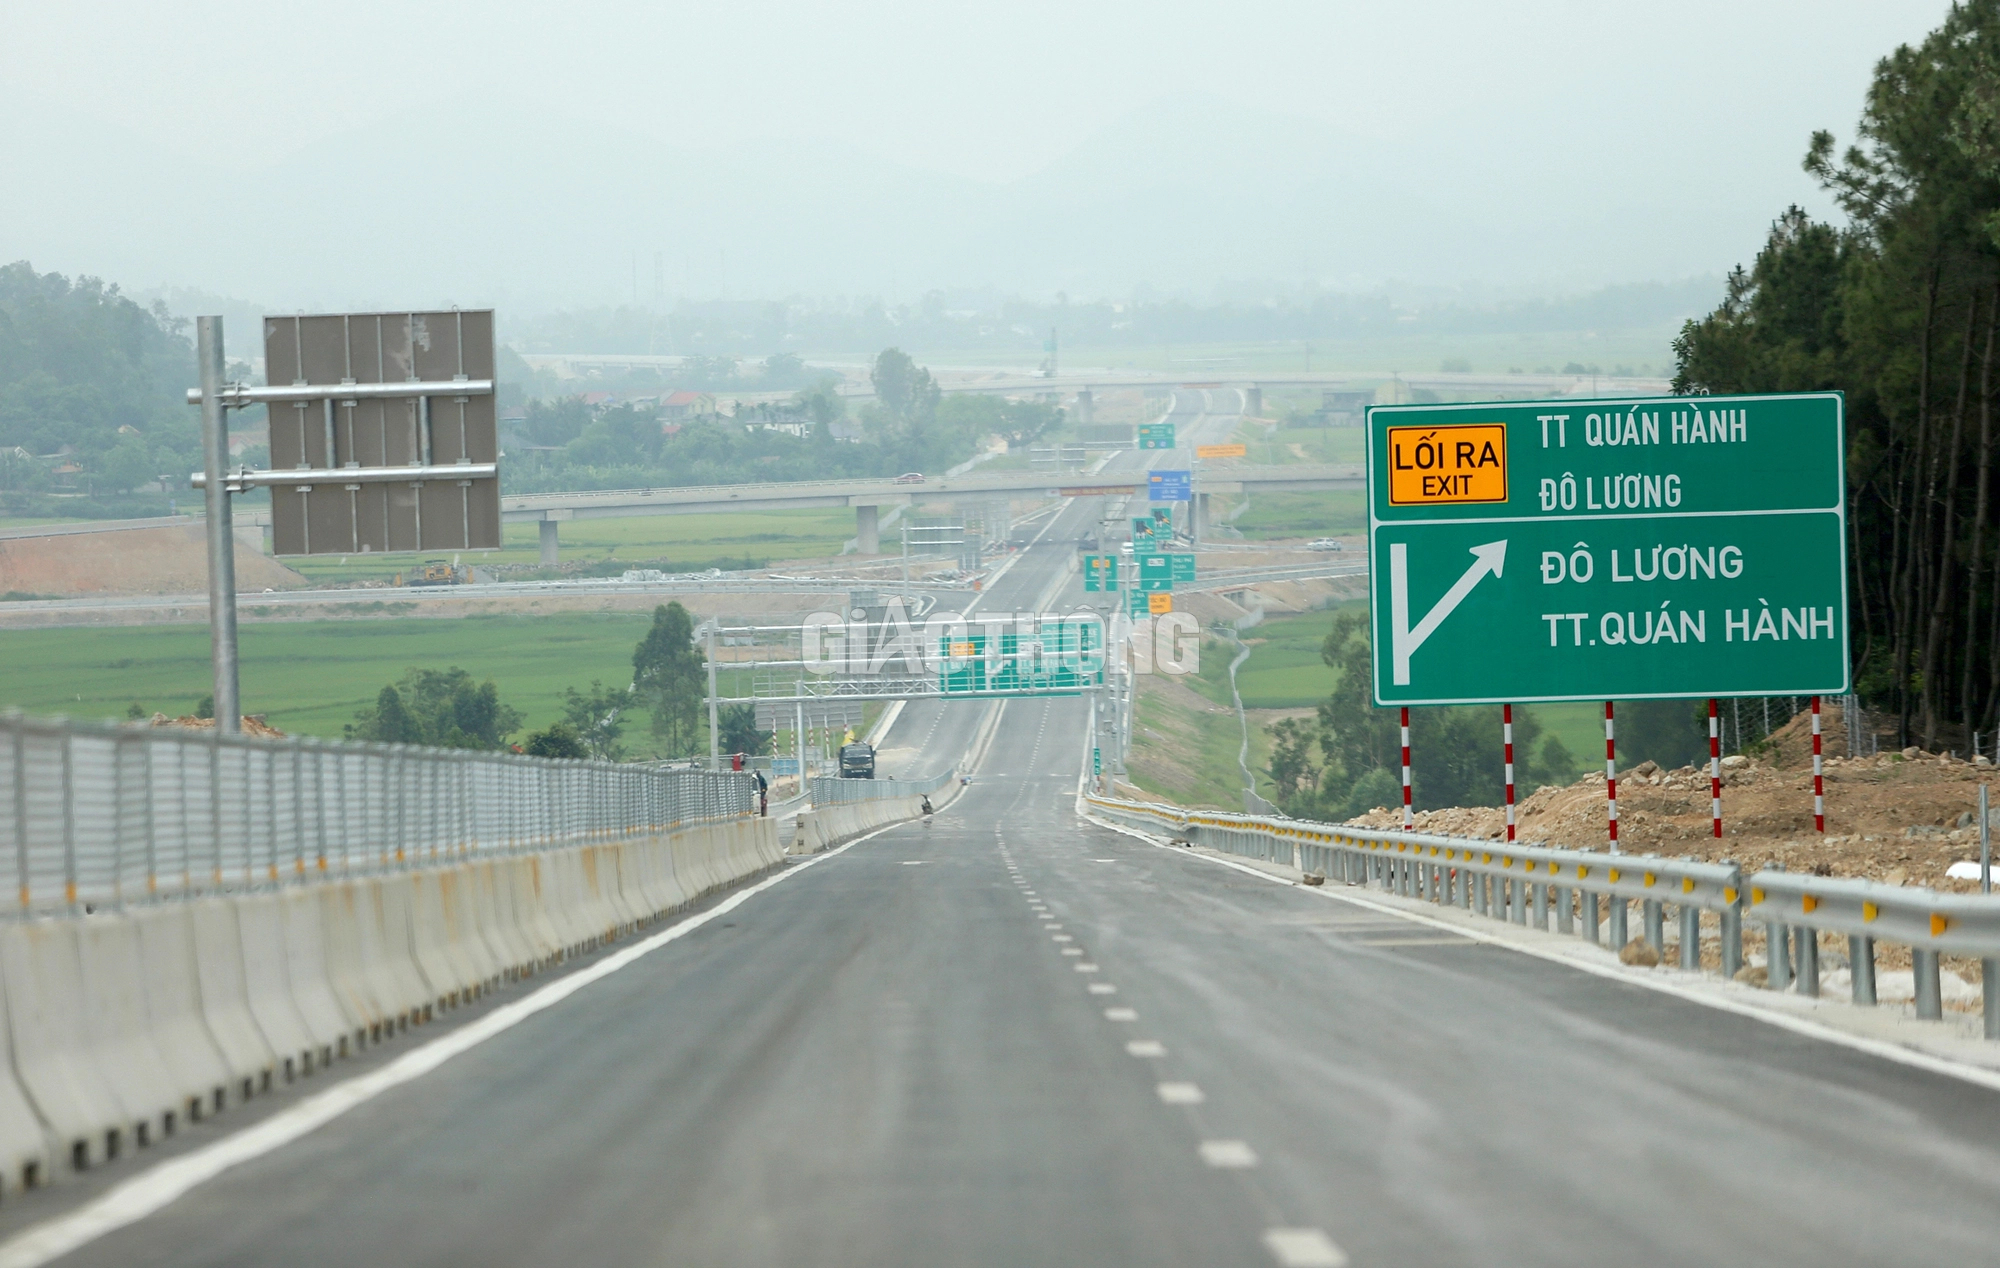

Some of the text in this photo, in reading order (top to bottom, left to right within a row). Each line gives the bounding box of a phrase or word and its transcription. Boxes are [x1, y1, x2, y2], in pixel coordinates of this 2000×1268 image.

[1536, 403, 1747, 448] TT QUÁN HÀNH
[1395, 431, 1500, 471] LỐI RA
[1422, 474, 1473, 497] EXIT
[1538, 471, 1681, 511] ĐÔ LƯƠNG
[1540, 541, 1743, 584] ĐÔ LƯƠNG
[1541, 597, 1834, 647] TT.QUÁN HÀNH
